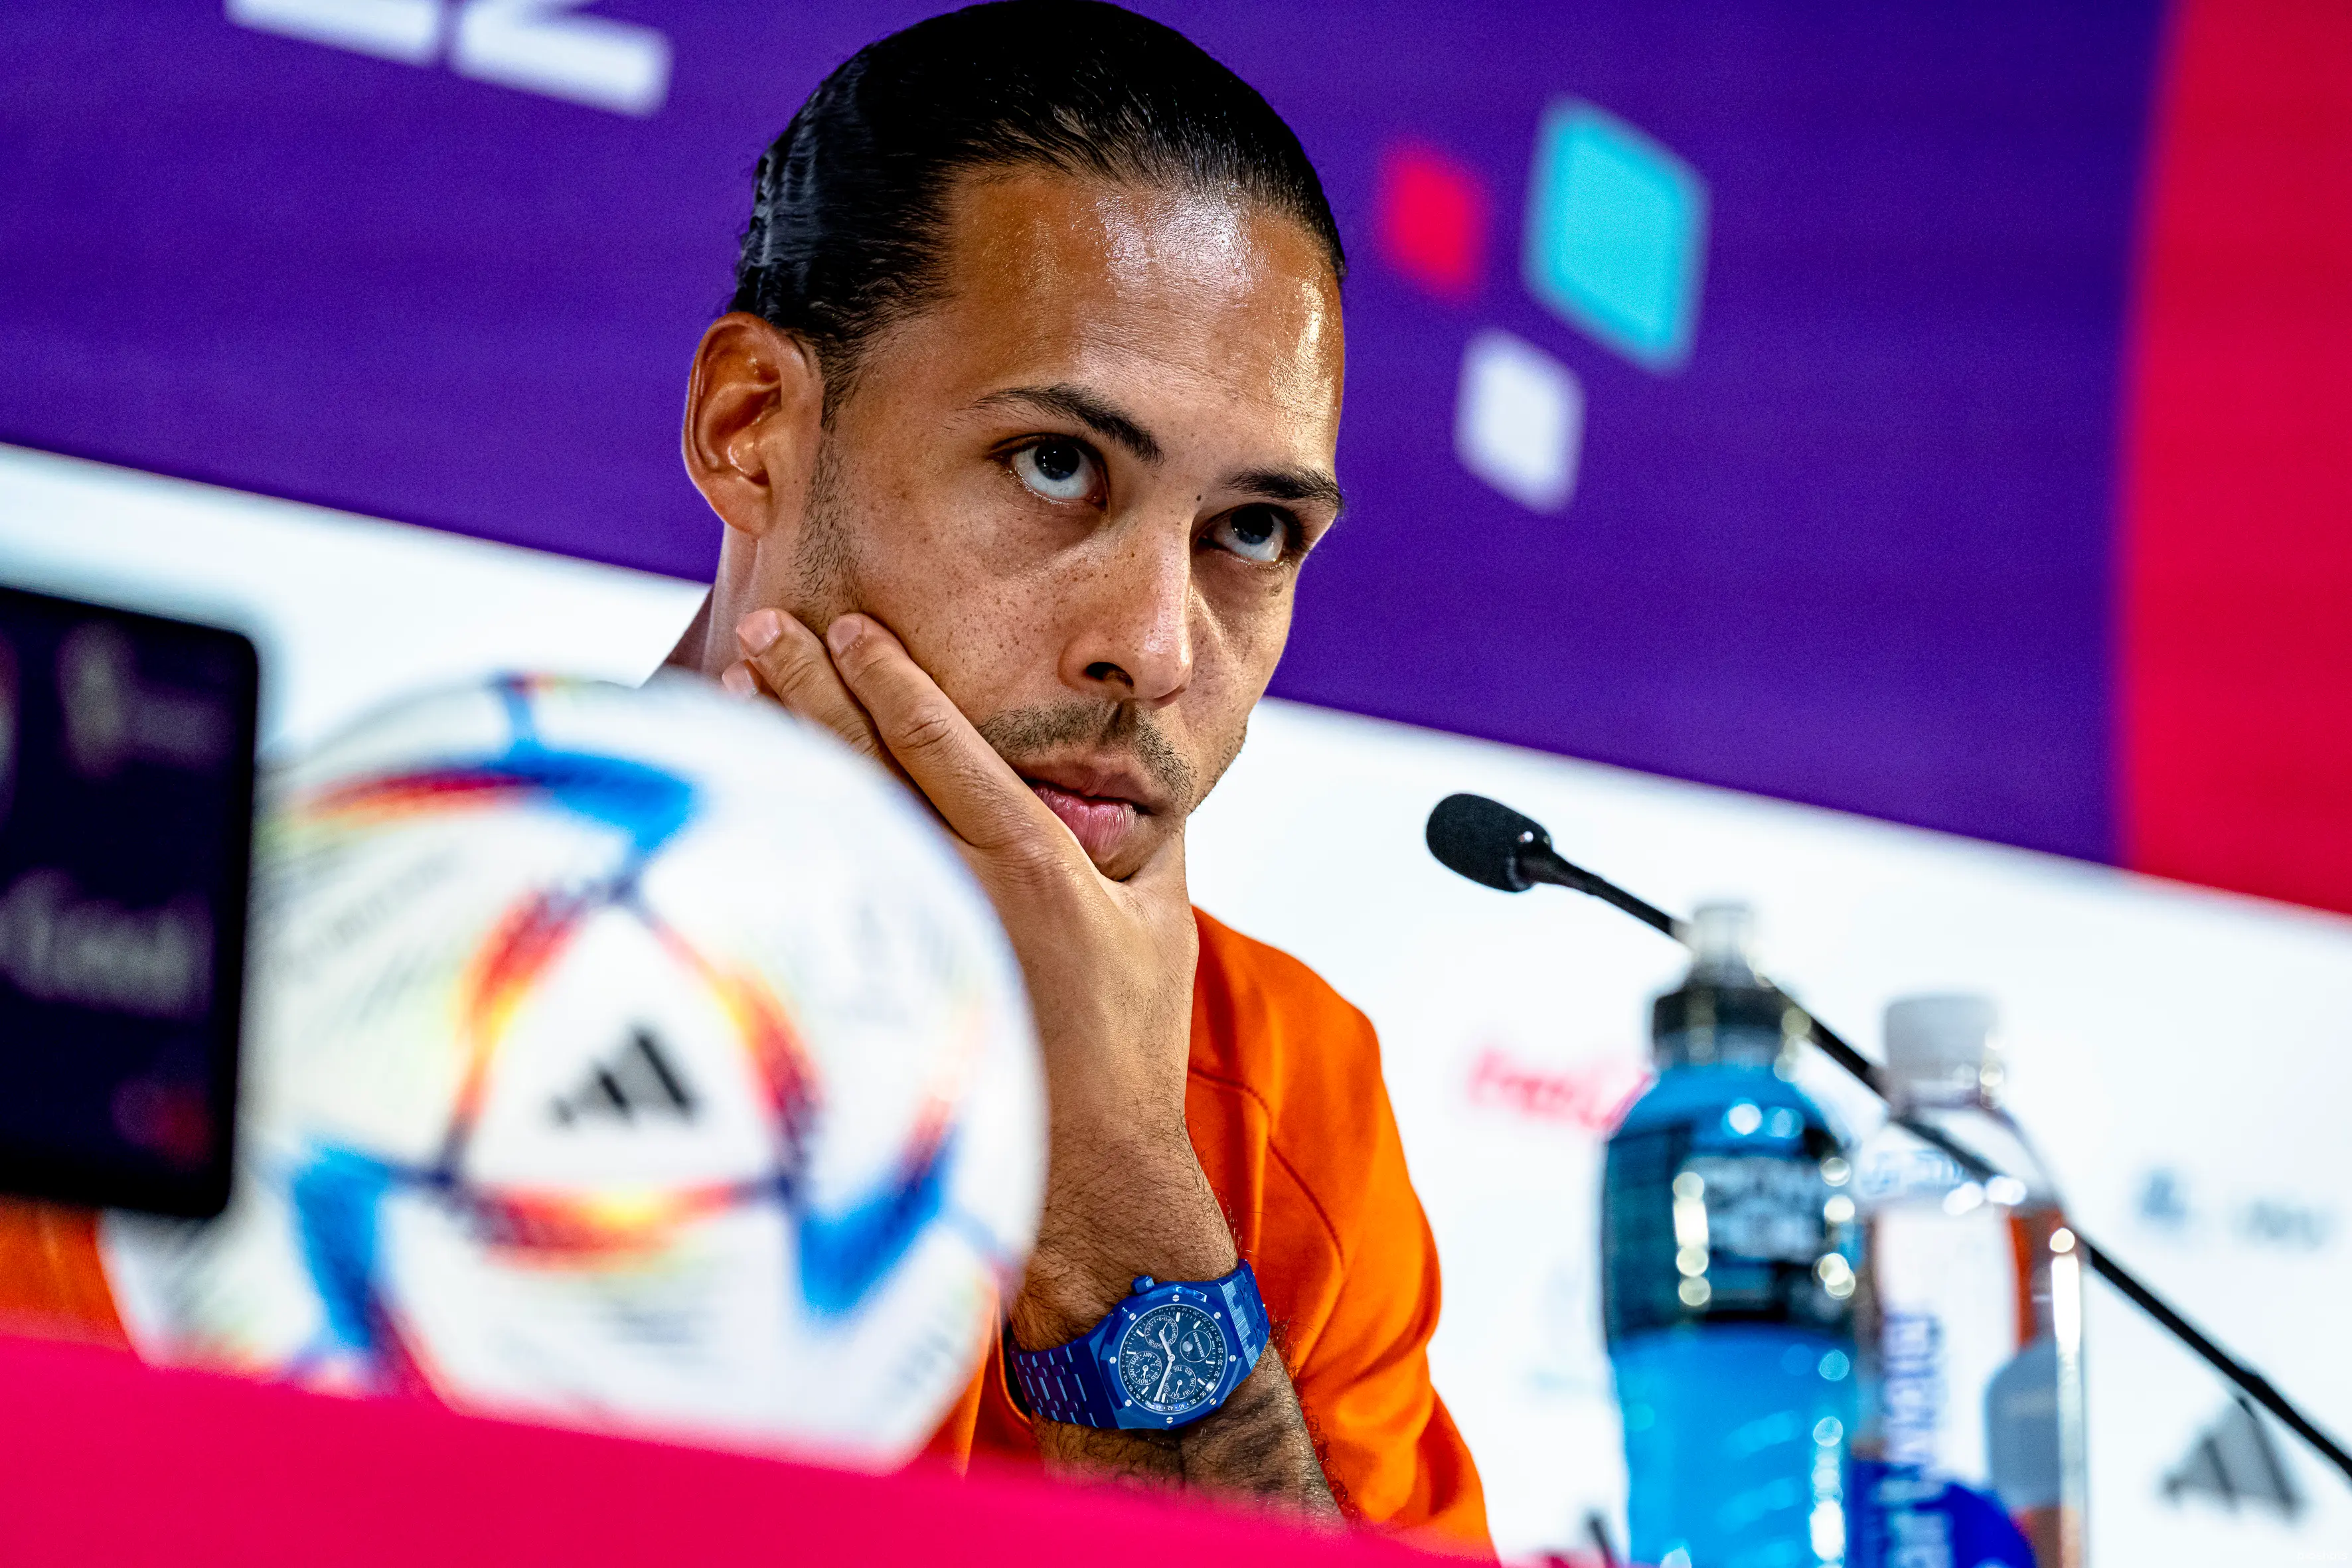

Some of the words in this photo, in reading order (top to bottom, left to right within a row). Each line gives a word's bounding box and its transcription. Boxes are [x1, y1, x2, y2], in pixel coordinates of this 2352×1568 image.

[1131, 1355, 1140, 1366] MAR
[1150, 1372, 1159, 1381] SEP
[1184, 1368, 1193, 1377] WED
